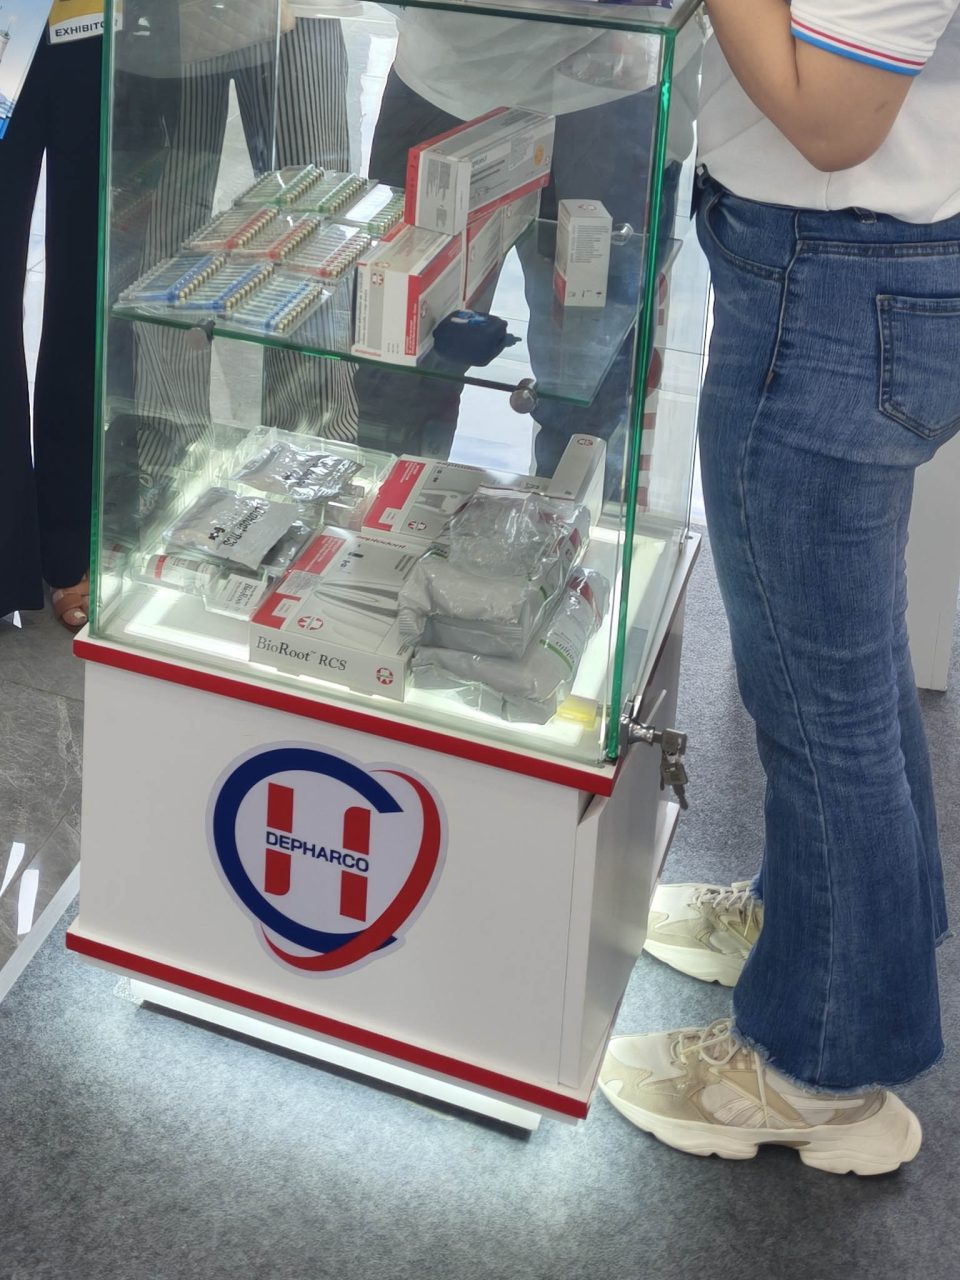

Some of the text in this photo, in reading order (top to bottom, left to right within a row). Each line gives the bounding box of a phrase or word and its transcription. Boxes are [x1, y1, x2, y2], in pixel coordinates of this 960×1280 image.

[55, 21, 105, 37] EXHIBIT
[319, 654, 347, 671] RCS
[266, 830, 369, 873] DEPHARCO
